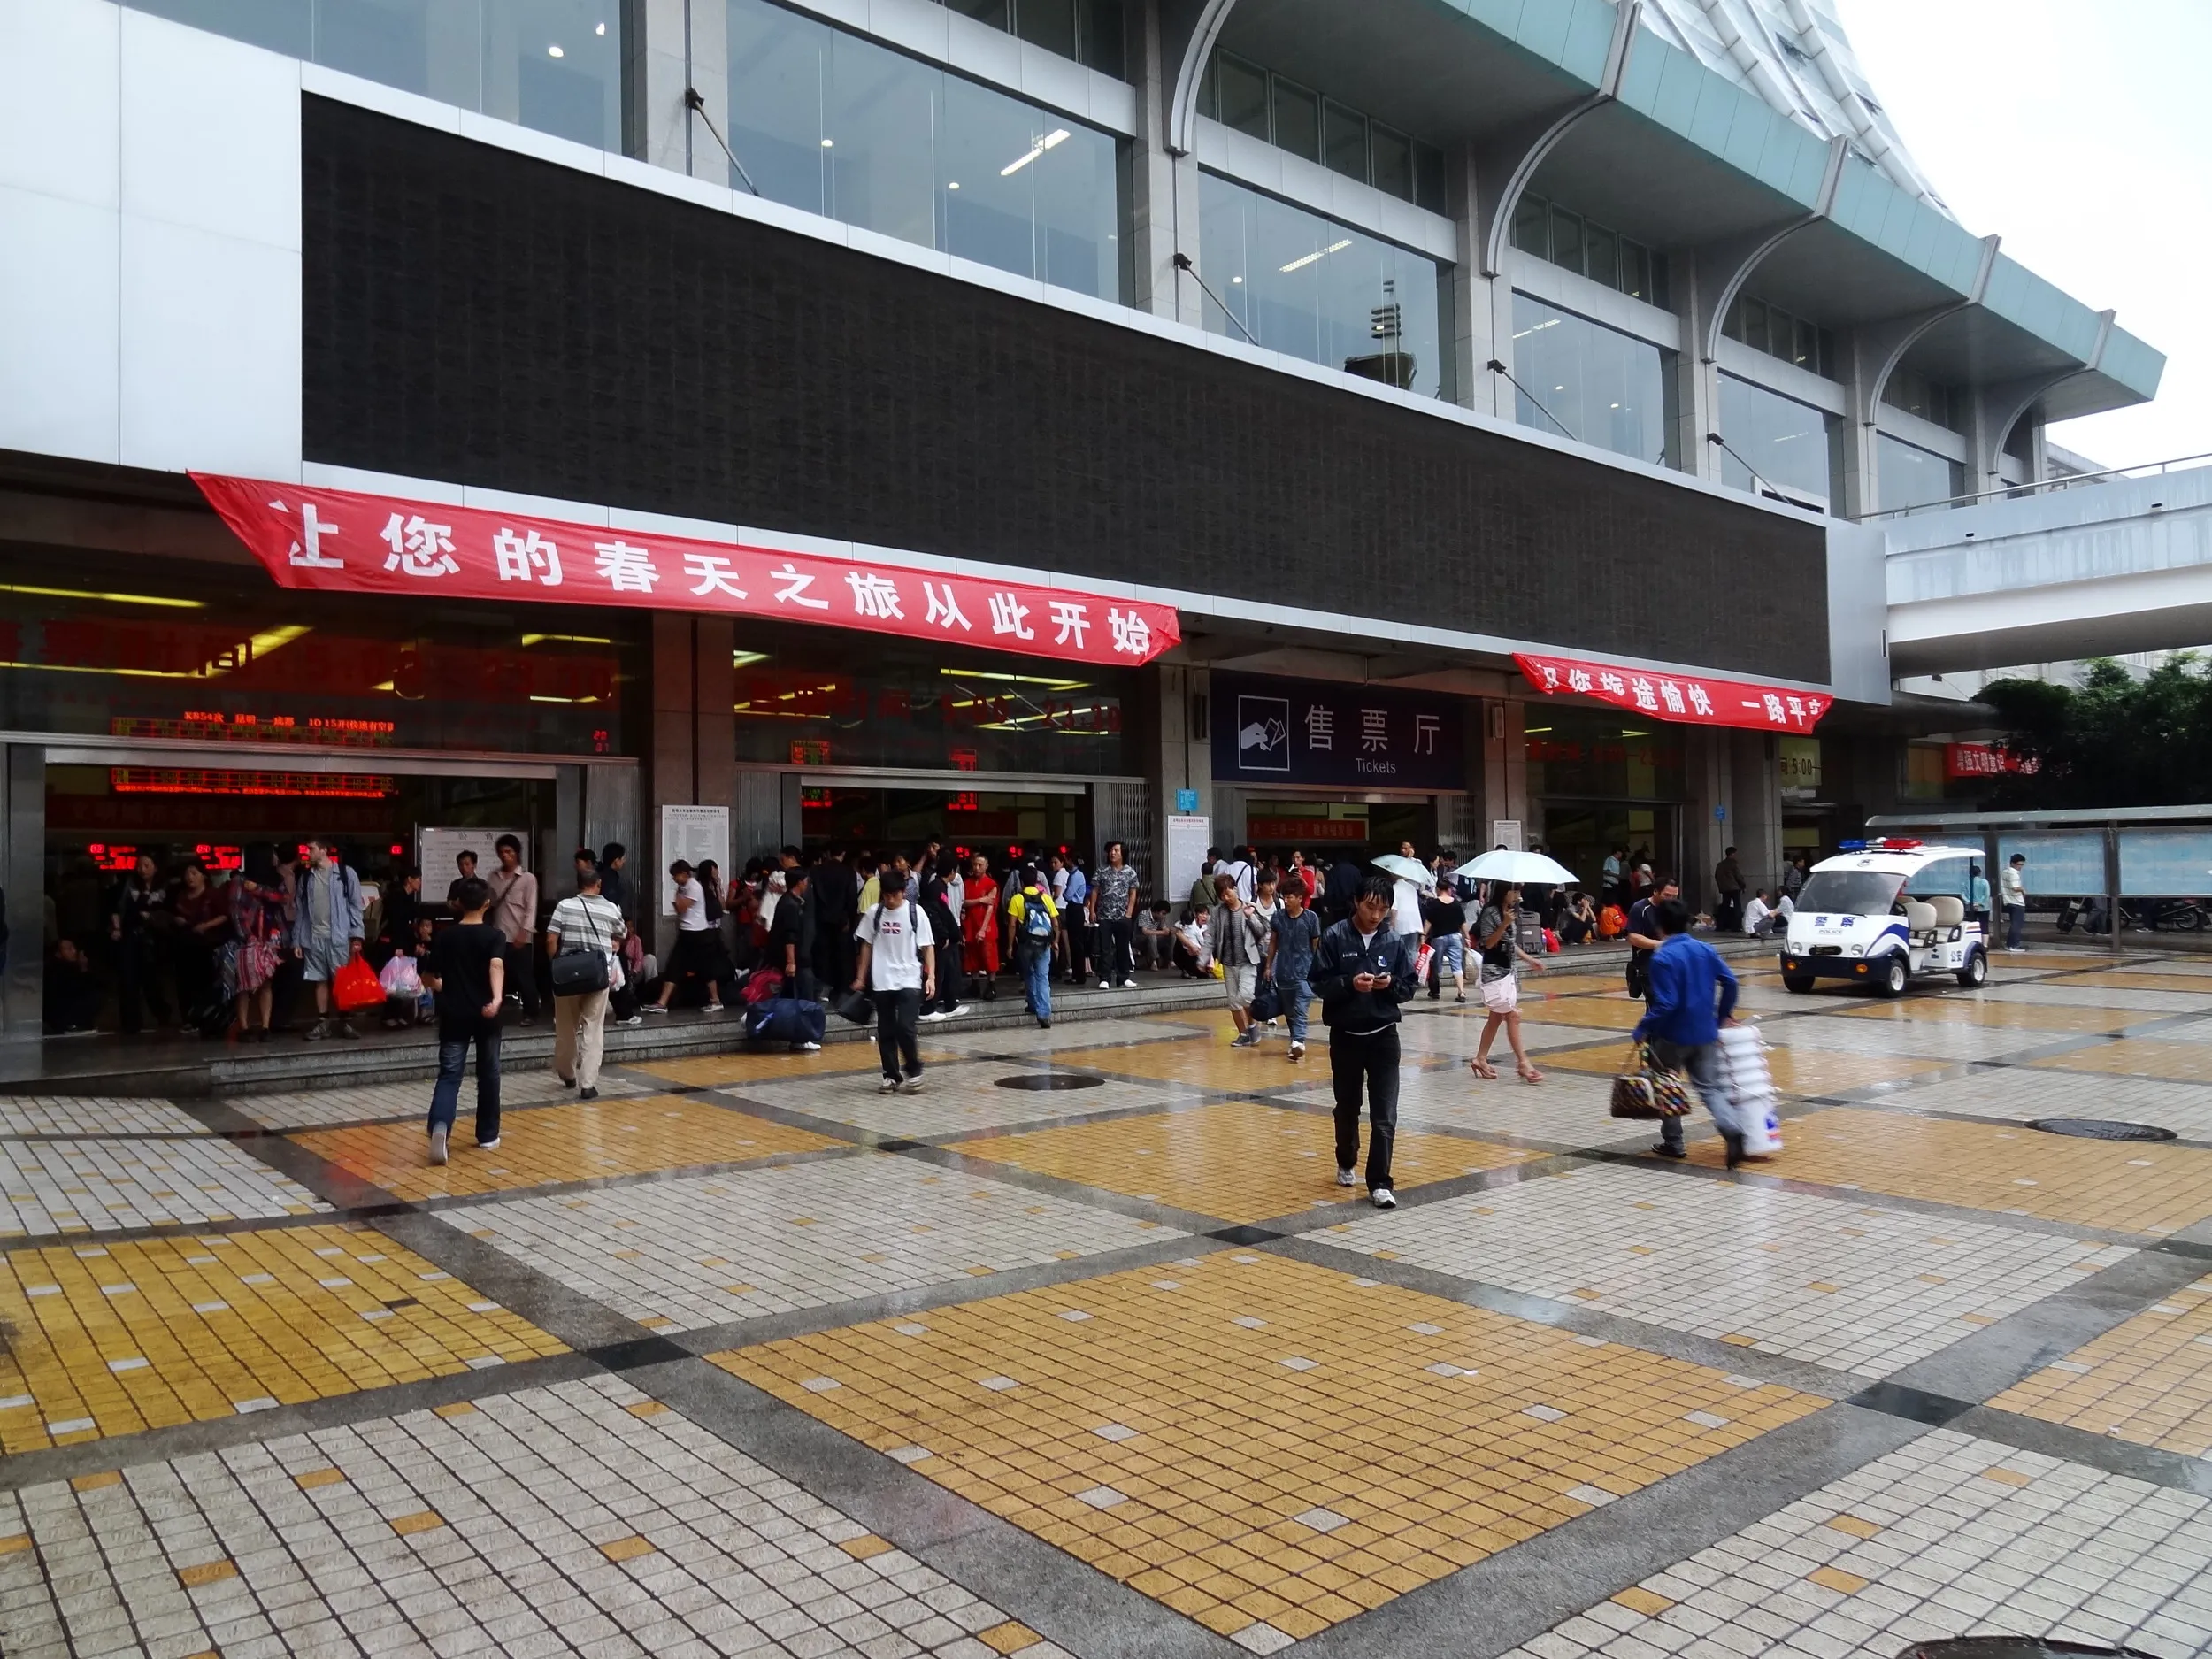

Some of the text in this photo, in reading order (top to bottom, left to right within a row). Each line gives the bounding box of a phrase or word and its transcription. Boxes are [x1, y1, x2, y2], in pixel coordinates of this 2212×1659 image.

[268, 499, 1151, 656] 让您的春天之旅从此开始
[1304, 704, 1440, 755] 售票厅
[1356, 757, 1397, 774] Tickets
[1814, 916, 1855, 927] 警察
